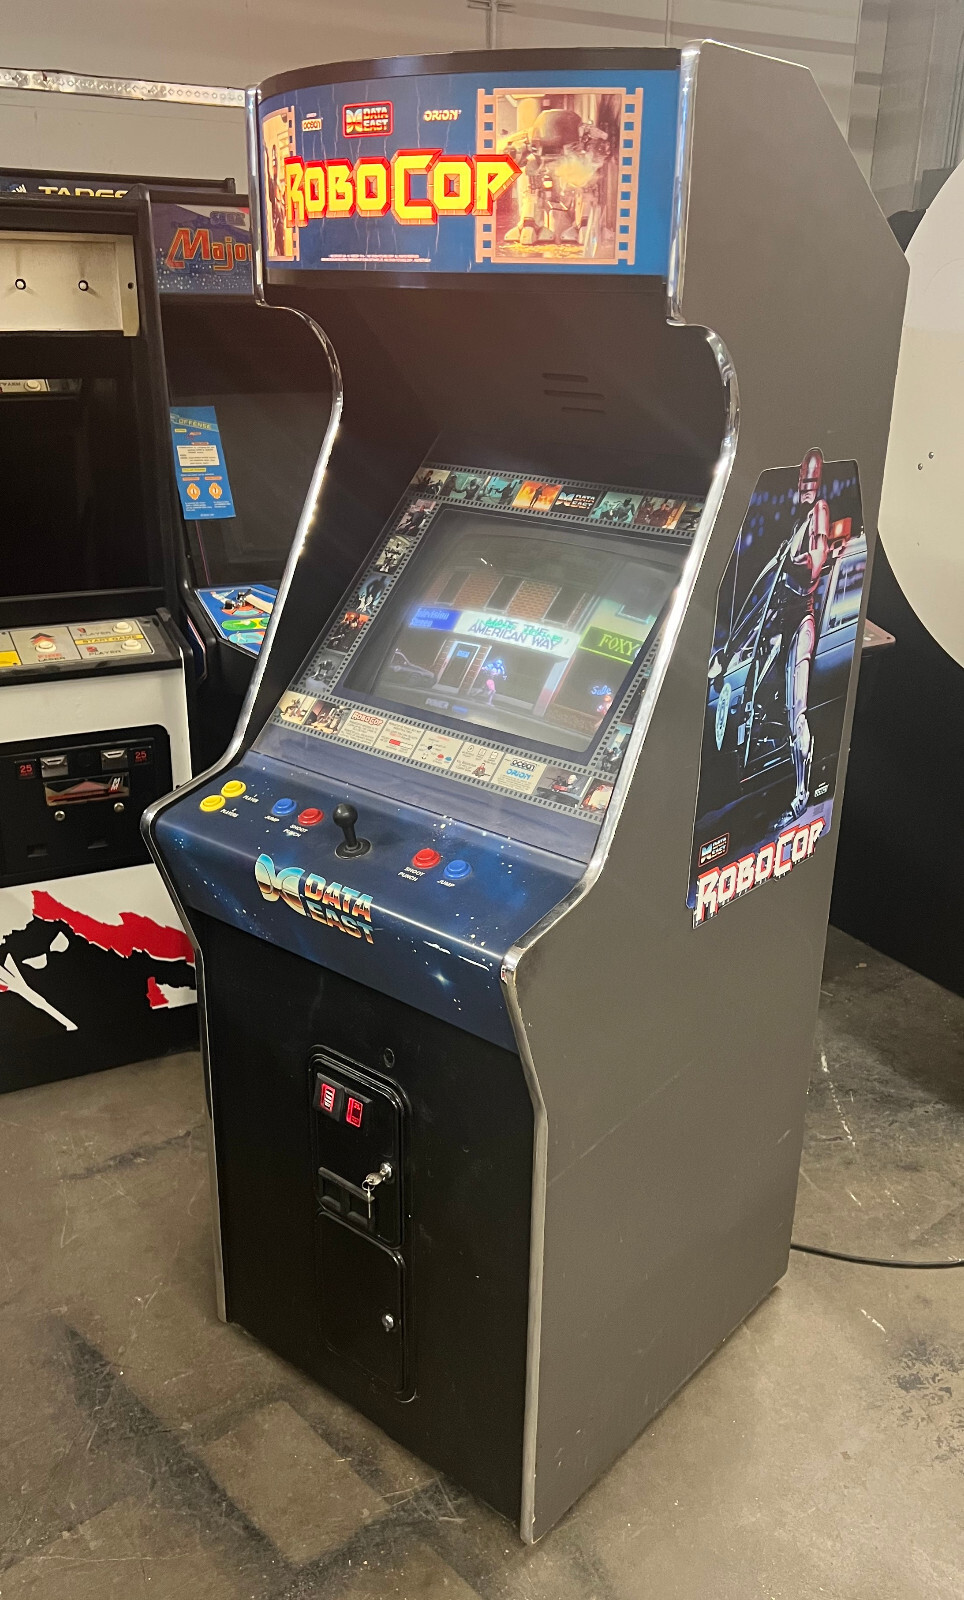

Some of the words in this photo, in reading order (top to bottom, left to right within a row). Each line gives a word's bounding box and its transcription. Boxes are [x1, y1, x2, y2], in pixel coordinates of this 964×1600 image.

[363, 107, 388, 119] DATA
[423, 110, 459, 121] ORION
[363, 120, 388, 132] EAST
[574, 494, 595, 503] DATA
[571, 501, 592, 509] EAST
[468, 622, 528, 645] AMERICAN
[531, 635, 562, 651] WAY
[598, 633, 640, 656] FOXY
[134, 751, 147, 760] 25
[20, 765, 33, 774] 25
[506, 769, 532, 780] ORION
[397, 871, 419, 882] PUNCH
[403, 866, 426, 877] SHOOT
[436, 879, 456, 888] JUMP
[304, 873, 374, 923] DATA
[305, 899, 376, 945] EAST
